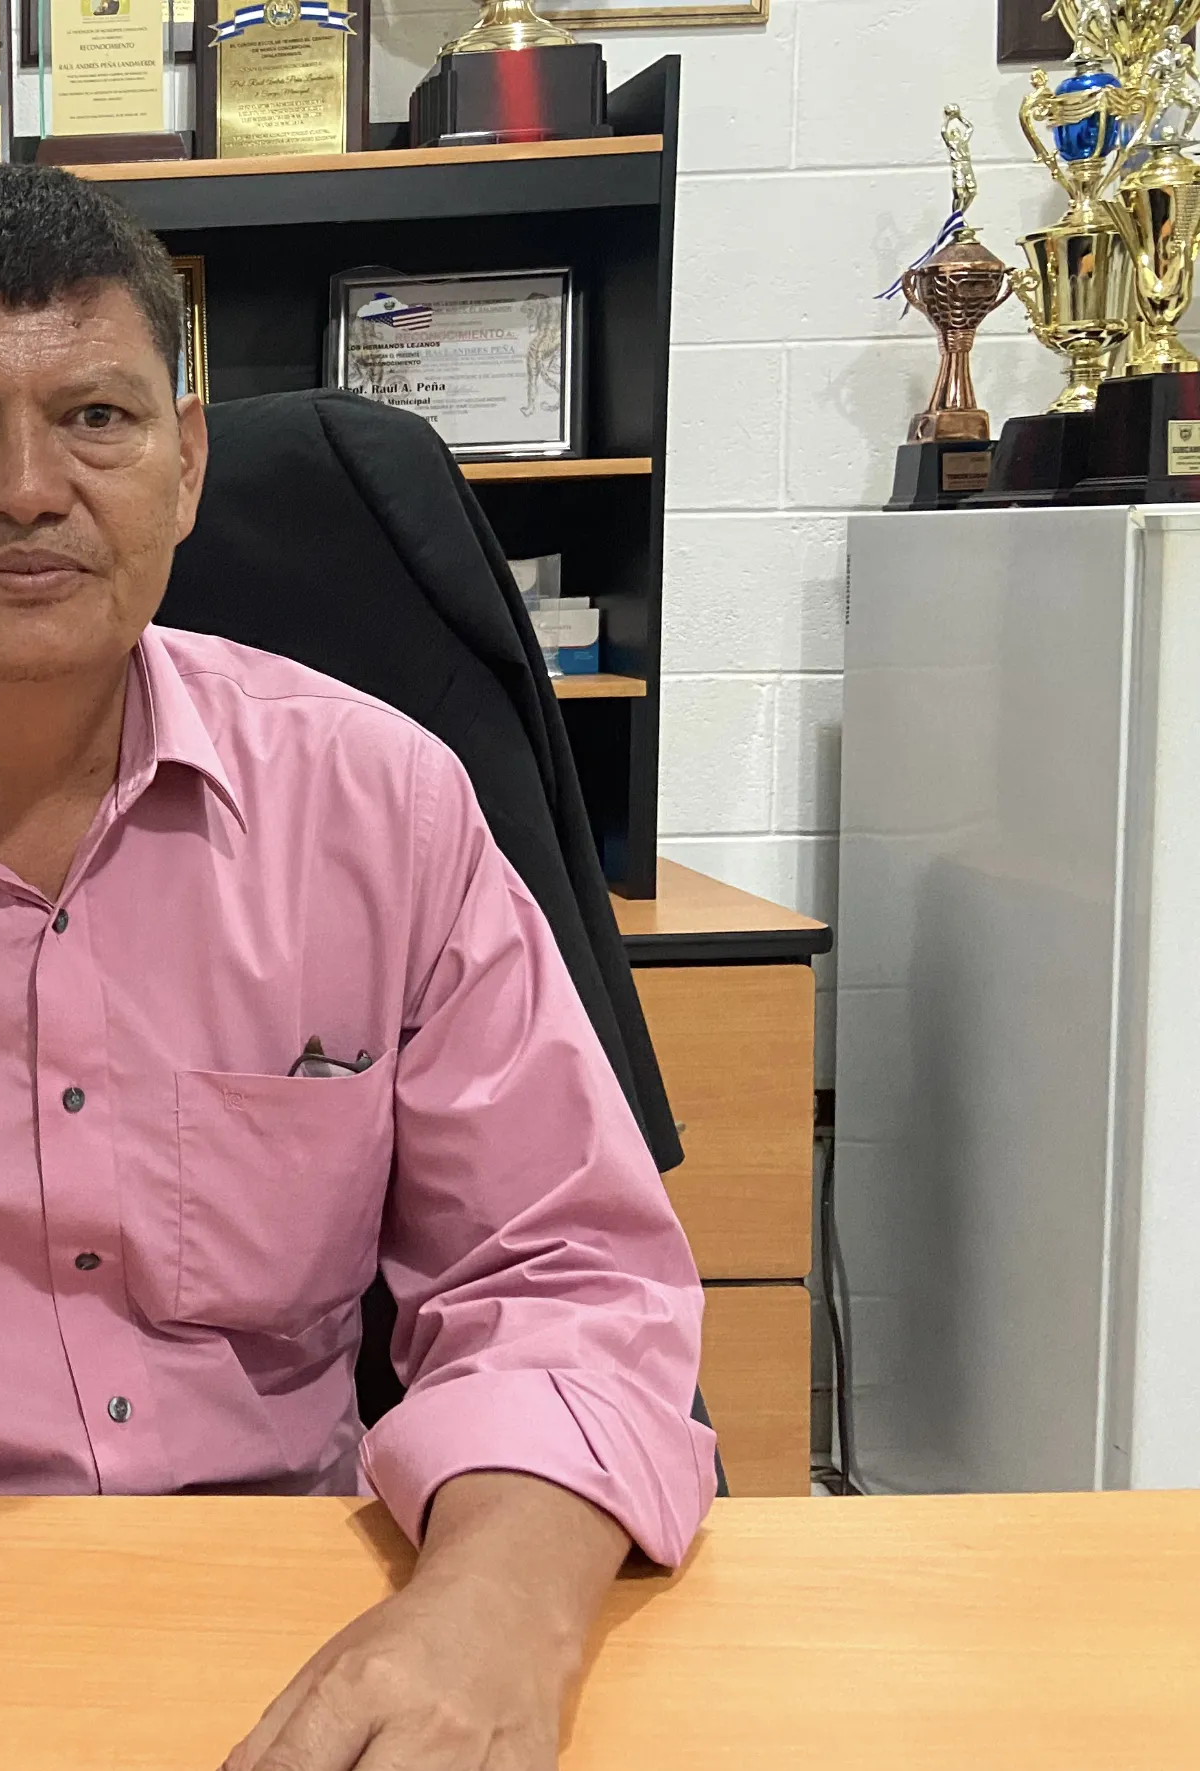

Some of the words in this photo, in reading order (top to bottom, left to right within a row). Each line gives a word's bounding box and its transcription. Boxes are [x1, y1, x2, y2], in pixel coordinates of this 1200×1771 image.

[80, 42, 135, 51] RECONOCIMIENTO
[394, 329, 504, 340] RECONOCIMIENTO
[362, 342, 404, 350] HERMANOS
[406, 341, 440, 349] LEJANOS
[371, 384, 398, 394] Raúl
[400, 383, 412, 392] A.
[416, 382, 446, 392] Peña
[387, 397, 431, 406] Municipal
